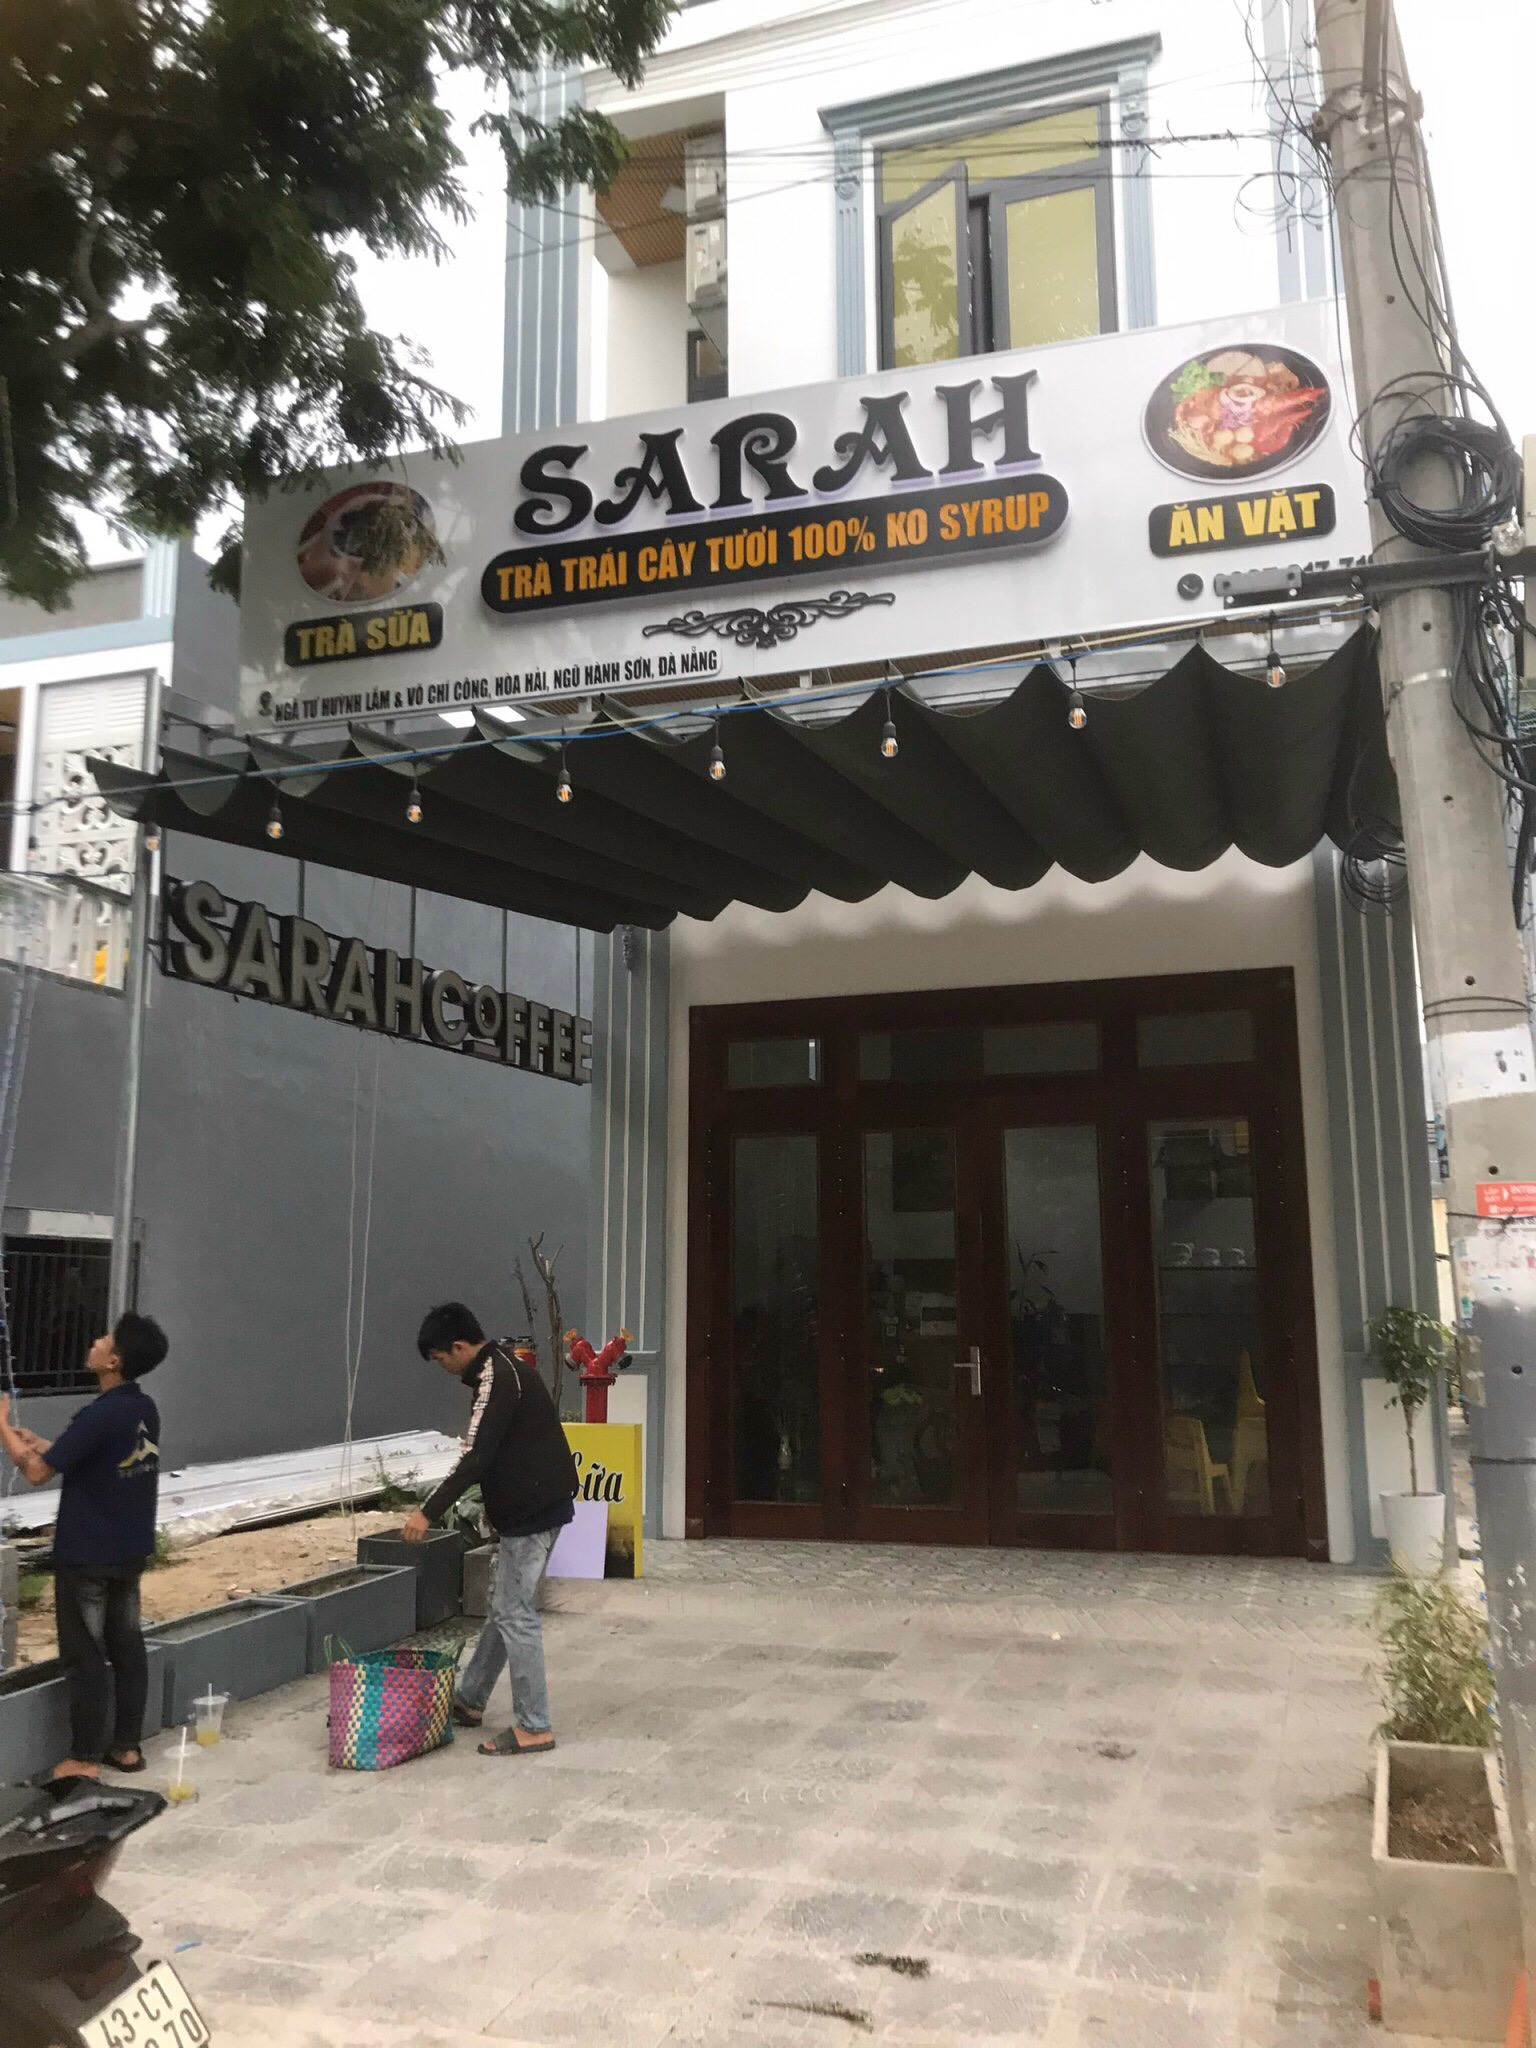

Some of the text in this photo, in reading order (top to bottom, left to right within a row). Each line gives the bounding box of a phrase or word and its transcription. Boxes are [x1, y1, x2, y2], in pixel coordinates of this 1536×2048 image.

[513, 368, 1042, 535] SARAH
[496, 491, 1051, 601] TRÀ TRÁI CÂY TƯƠI 100% KO SYRUP
[1168, 489, 1322, 548] ĂN VẶT
[295, 608, 431, 661] TRÀ SỮA
[394, 691, 403, 708] &
[494, 673, 521, 697] HÒA
[584, 660, 621, 686] HÀNH
[658, 652, 677, 677] ĐÀ
